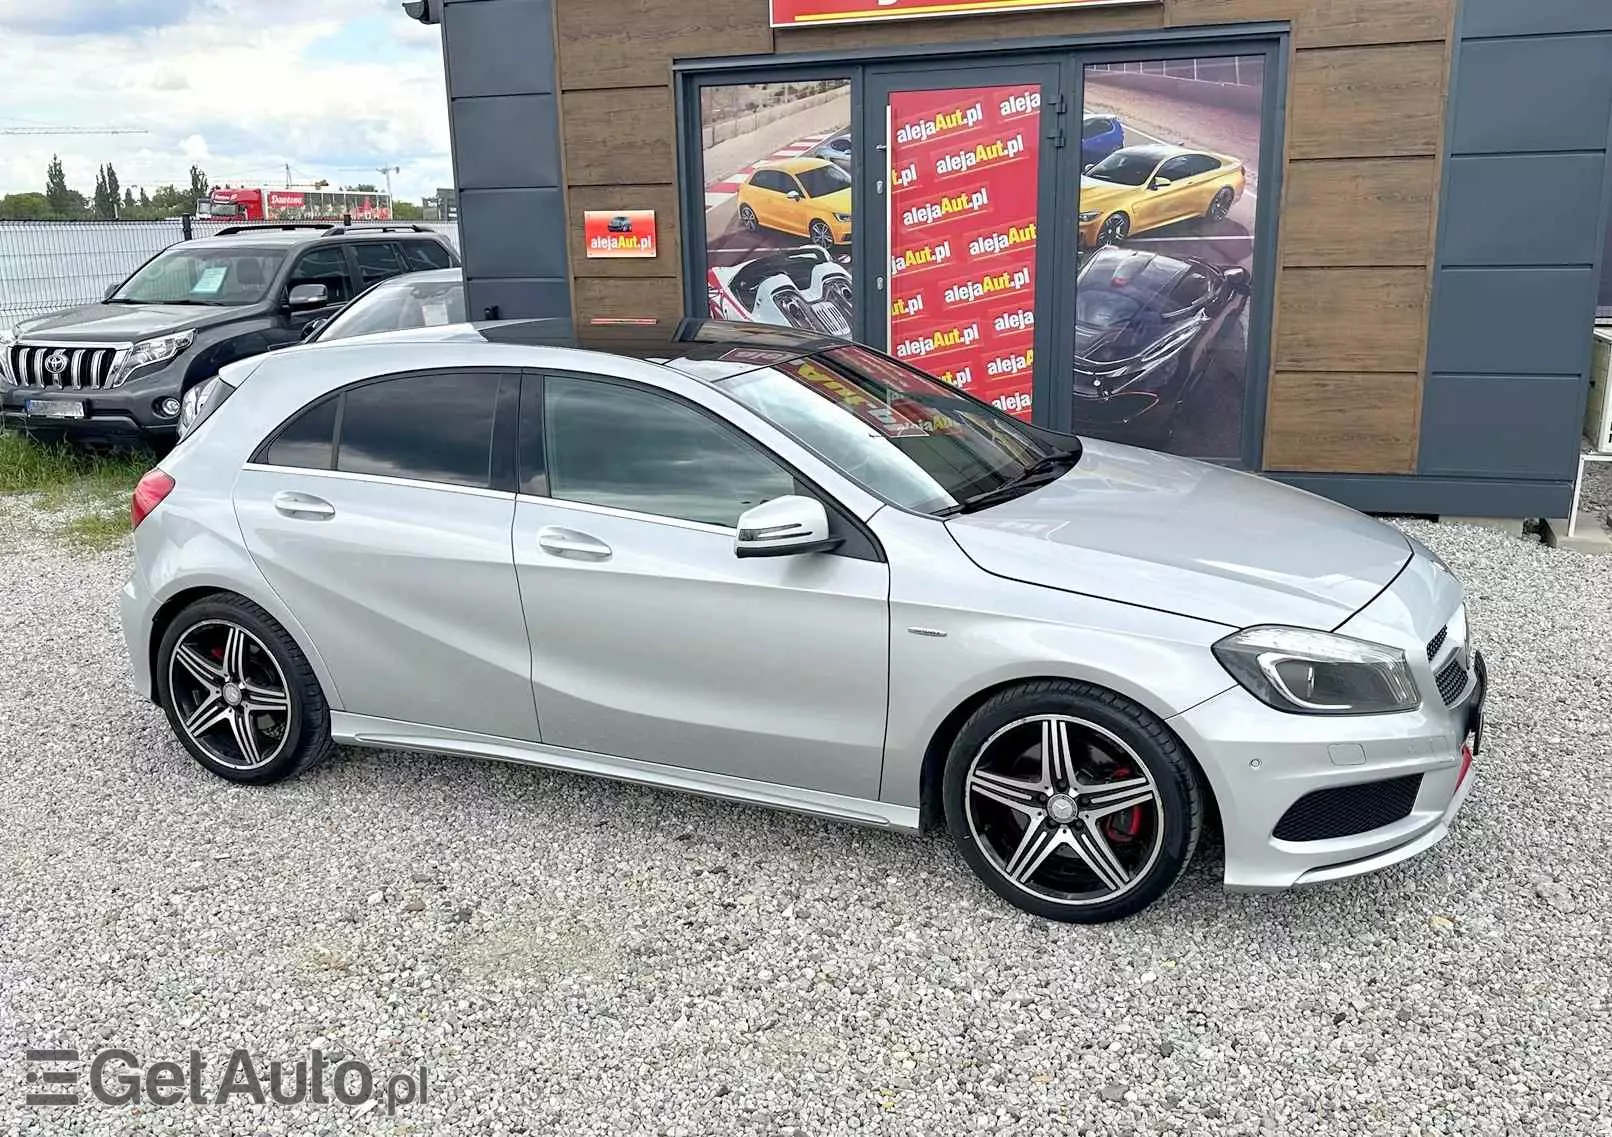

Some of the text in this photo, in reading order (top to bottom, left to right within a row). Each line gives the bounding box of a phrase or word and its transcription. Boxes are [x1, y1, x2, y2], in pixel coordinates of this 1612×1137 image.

[999, 91, 1040, 116] aleja
[896, 102, 983, 143] alejaAut.pl
[936, 134, 1024, 174] alejaAut.pl
[903, 187, 988, 226] alejaAut.pl
[591, 235, 652, 251] alejaAut.pl
[969, 223, 1037, 255] alejaAut
[944, 267, 1031, 303] alejaAut.pl
[994, 309, 1035, 332] aleja
[896, 323, 980, 357] alejaAut.pl
